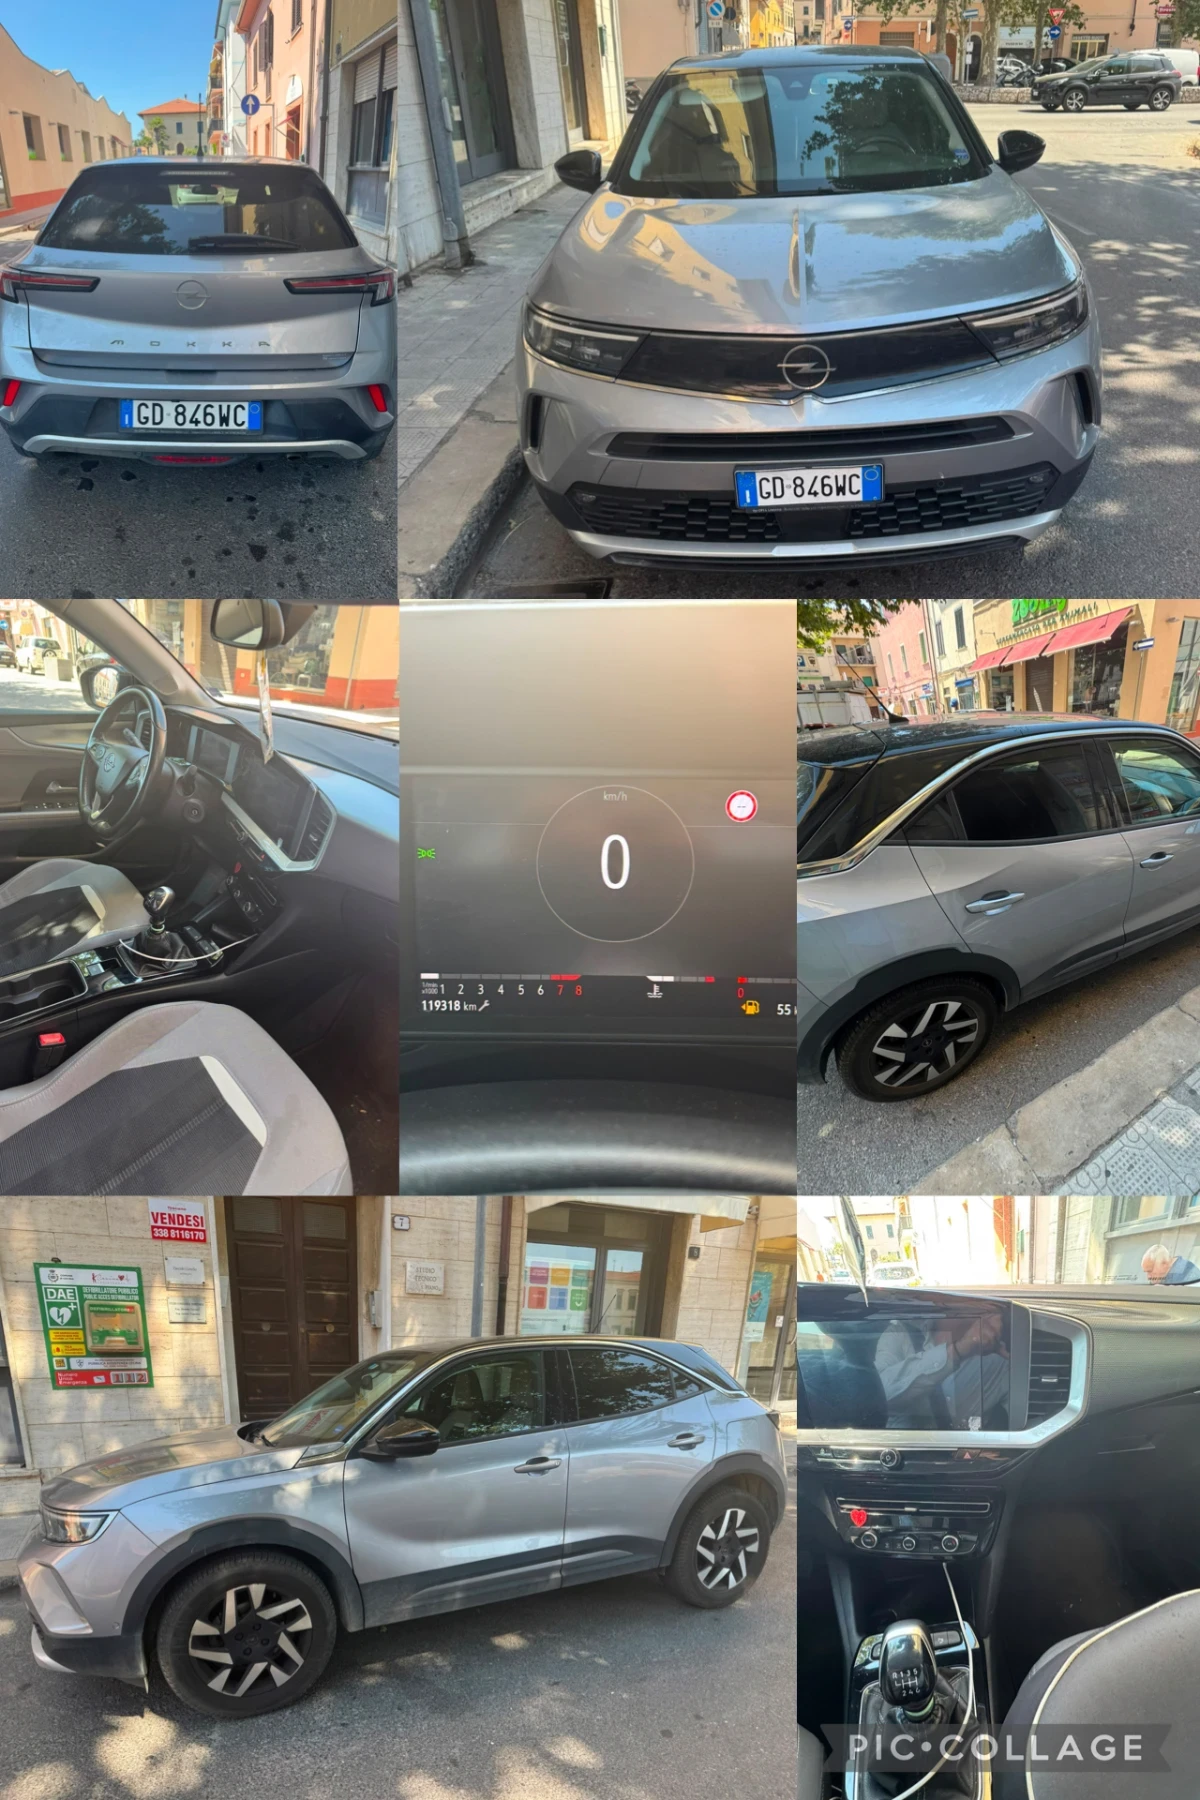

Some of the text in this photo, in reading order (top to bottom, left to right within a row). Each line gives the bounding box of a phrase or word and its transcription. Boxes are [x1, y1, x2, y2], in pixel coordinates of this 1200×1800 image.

[110, 339, 270, 347] MOKKA
[137, 402, 246, 427] GD 846WC
[759, 473, 861, 500] GD 846WC
[1060, 601, 1097, 622] ANIMALI
[603, 790, 628, 802] km/h
[601, 834, 630, 890] 0
[440, 984, 582, 996] 1 2 3 4 5 6 7 8
[737, 987, 745, 999] 0
[421, 999, 477, 1011] 119318 km
[776, 1004, 792, 1016] 55
[151, 1211, 205, 1228] VENDESI
[399, 1218, 404, 1227] 7
[153, 1228, 205, 1240] 338 8116170
[414, 1275, 437, 1283] TECNICO
[46, 1288, 75, 1300] DAE
[82, 1286, 117, 1294] DEFIBRILLATORE
[113, 1372, 145, 1384] 112
[906, 1669, 911, 1677] 3
[913, 1668, 918, 1676] 5
